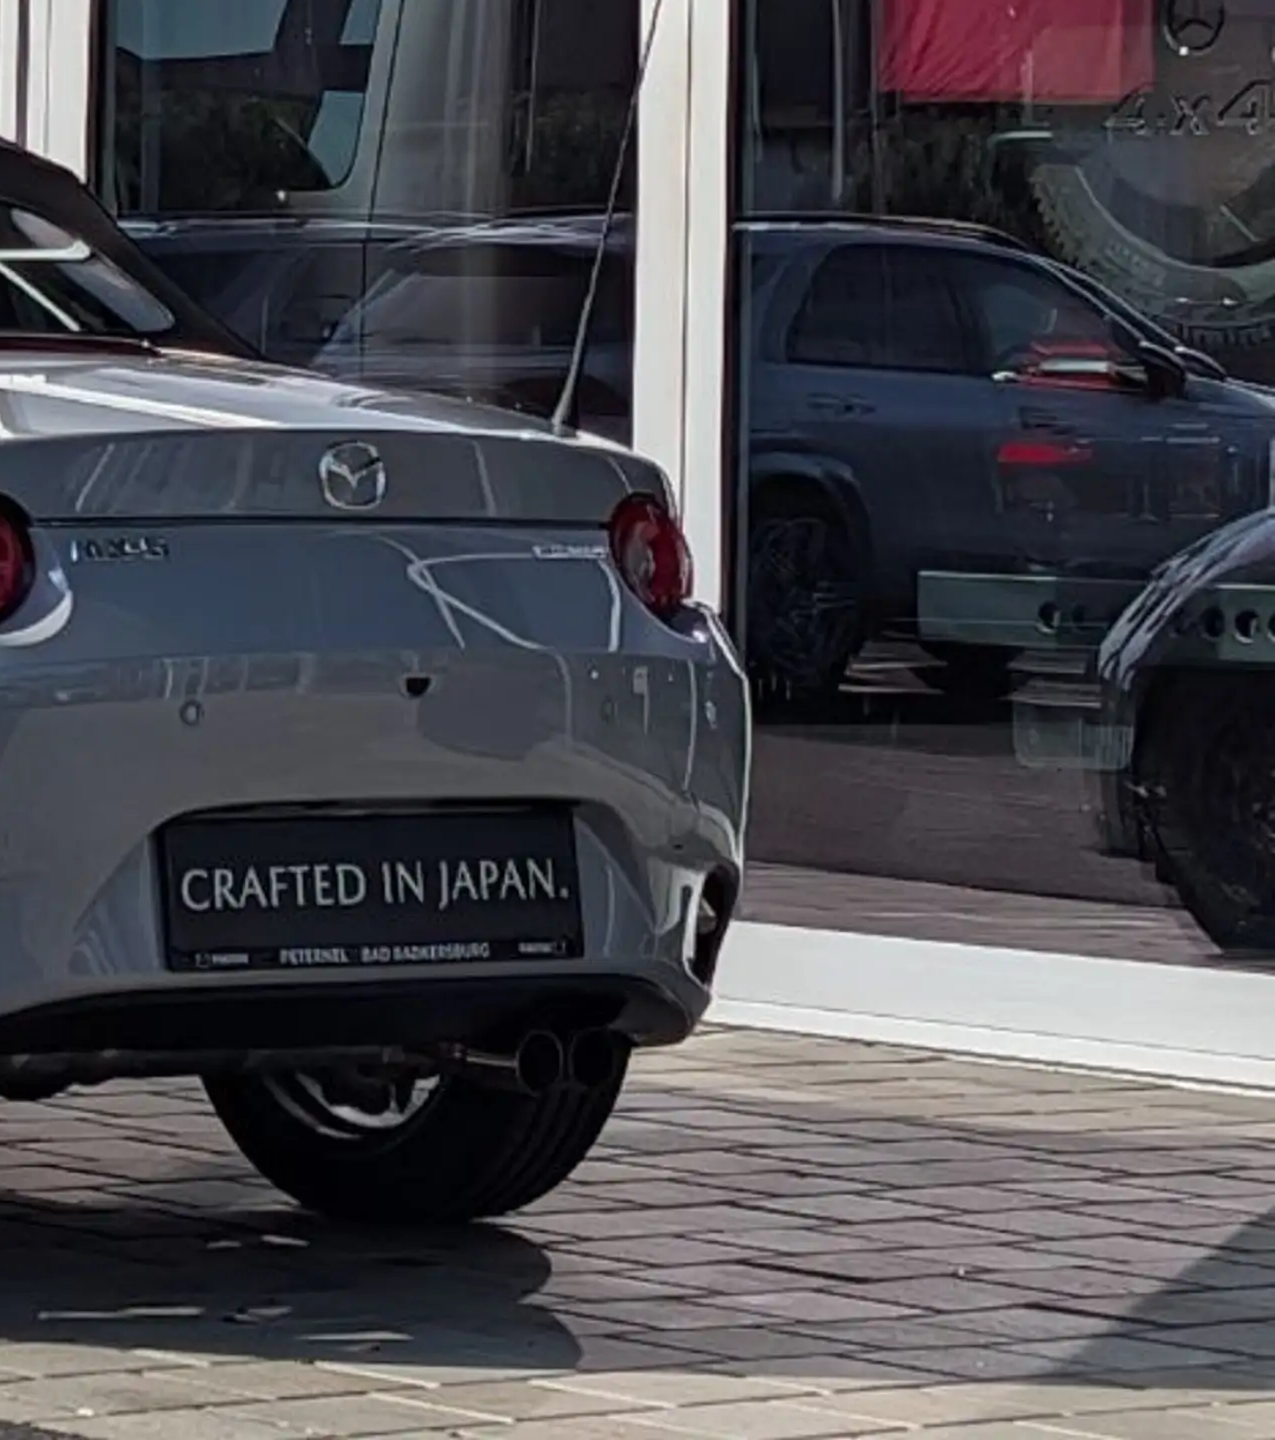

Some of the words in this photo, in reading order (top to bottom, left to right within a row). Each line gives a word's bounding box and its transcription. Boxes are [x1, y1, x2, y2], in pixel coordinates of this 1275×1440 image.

[180, 863, 368, 911] CRAFTED
[381, 860, 425, 905] IN
[438, 857, 571, 911] JAPAN.
[361, 945, 391, 964] BAD
